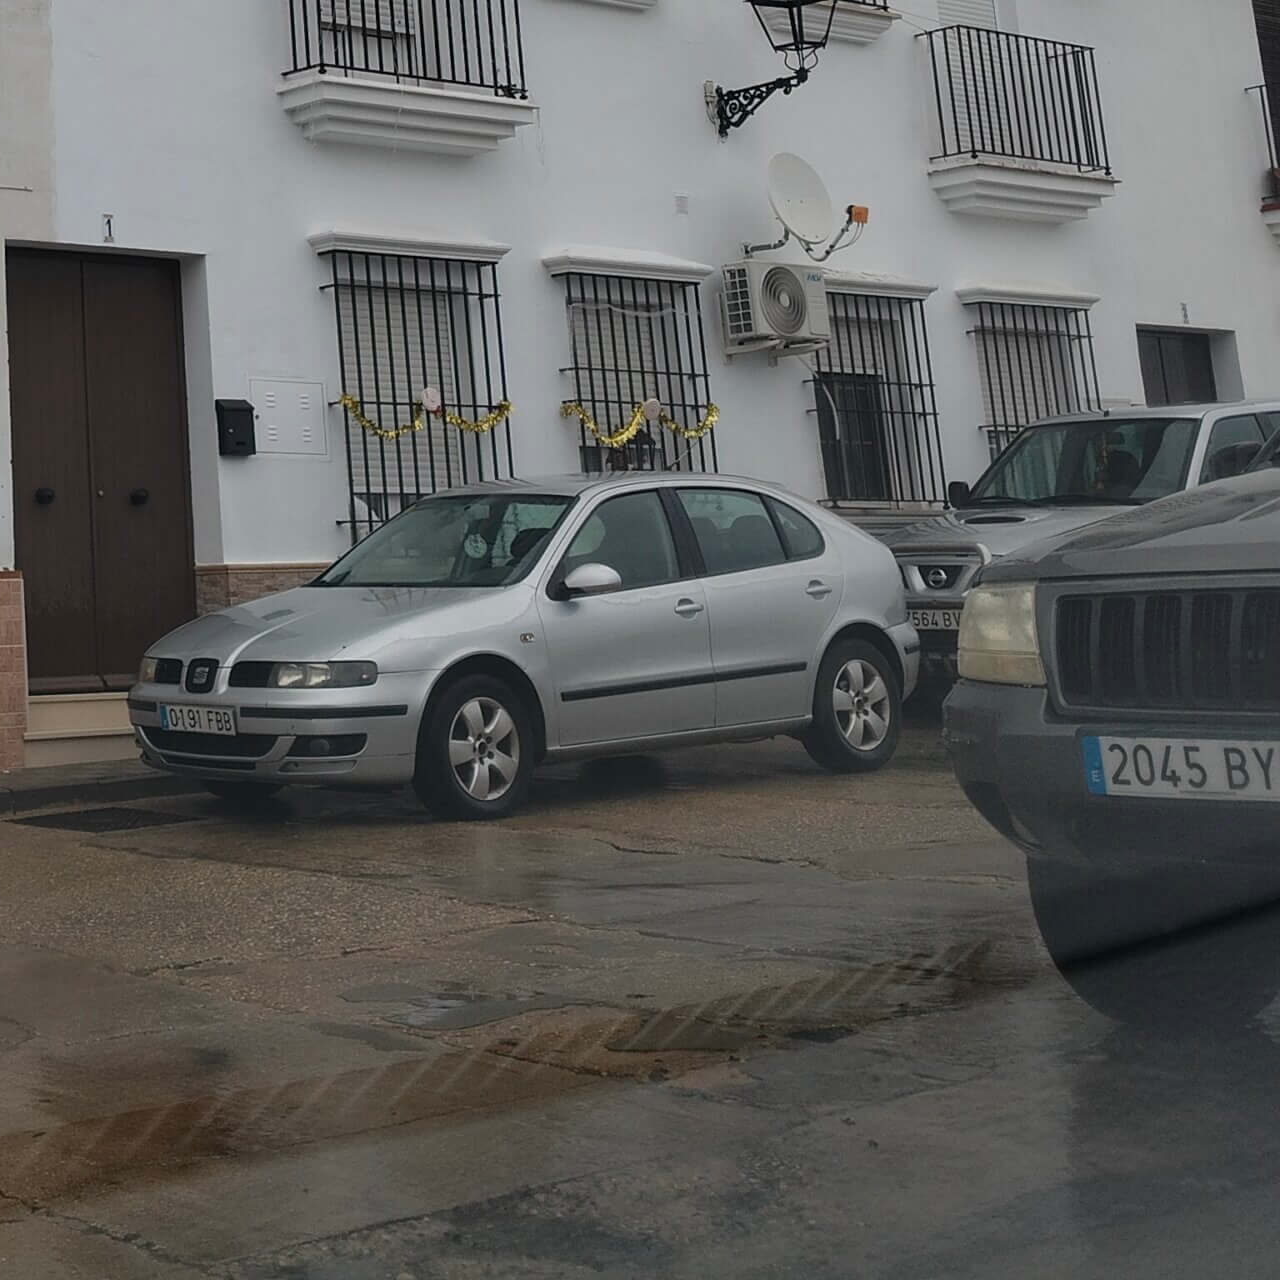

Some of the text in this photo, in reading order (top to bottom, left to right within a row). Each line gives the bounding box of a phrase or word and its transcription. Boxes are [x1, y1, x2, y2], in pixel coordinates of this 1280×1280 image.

[169, 708, 232, 732] 0191 FBB
[1108, 743, 1208, 789] 2045
[1223, 747, 1275, 790] BY
